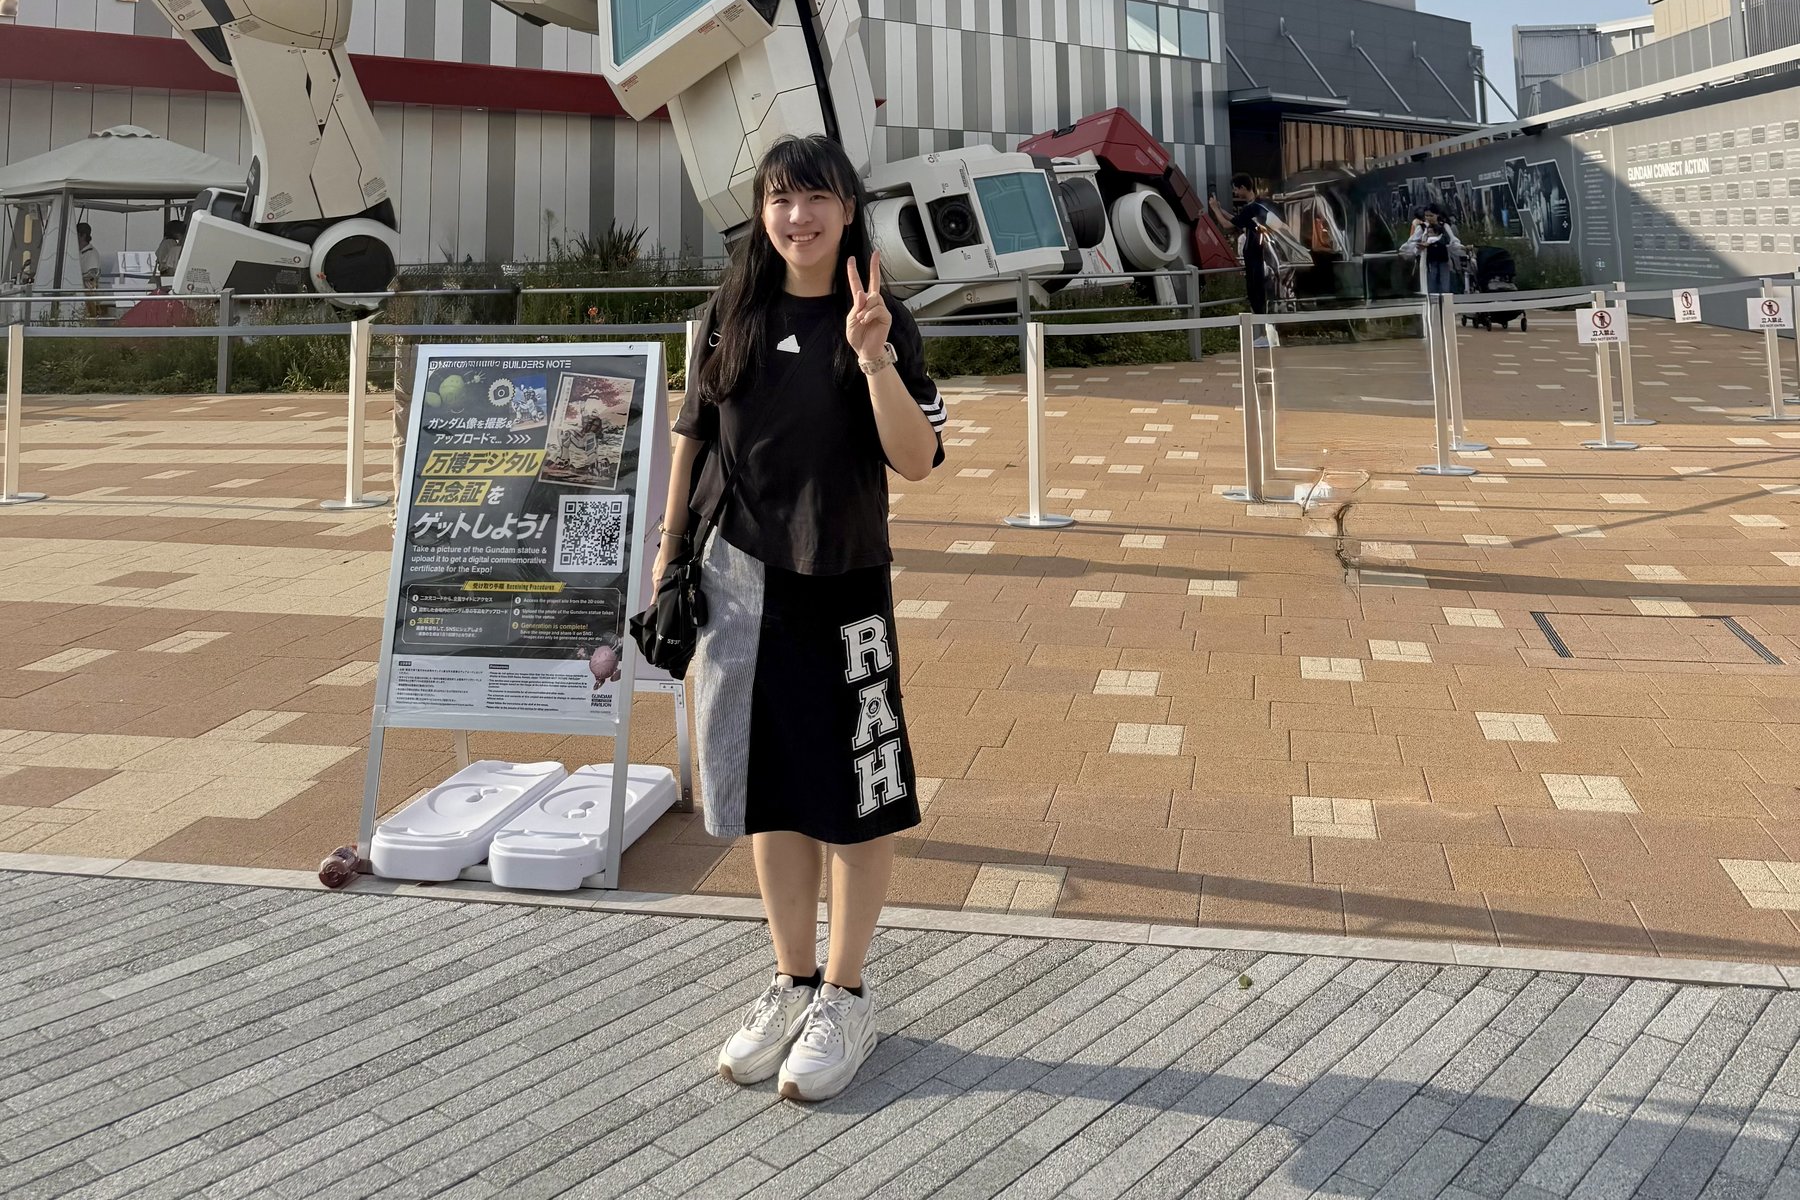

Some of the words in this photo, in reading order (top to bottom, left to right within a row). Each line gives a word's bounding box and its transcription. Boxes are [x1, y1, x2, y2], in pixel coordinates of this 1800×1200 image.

[1627, 164, 1653, 180] GUNDAM
[1654, 161, 1682, 178] CONNECT
[1684, 158, 1709, 175] ACTION
[502, 361, 544, 369] BUILDERS
[546, 360, 571, 369] NOTE
[426, 452, 538, 474] 万博デジタル
[437, 546, 461, 554] picture
[486, 546, 516, 554] Gundam
[411, 555, 435, 563] upload
[450, 556, 461, 564] get
[468, 556, 489, 564] digital
[490, 556, 546, 564] commemorative
[471, 566, 492, 574] Expo!
[840, 614, 907, 818] RAH
